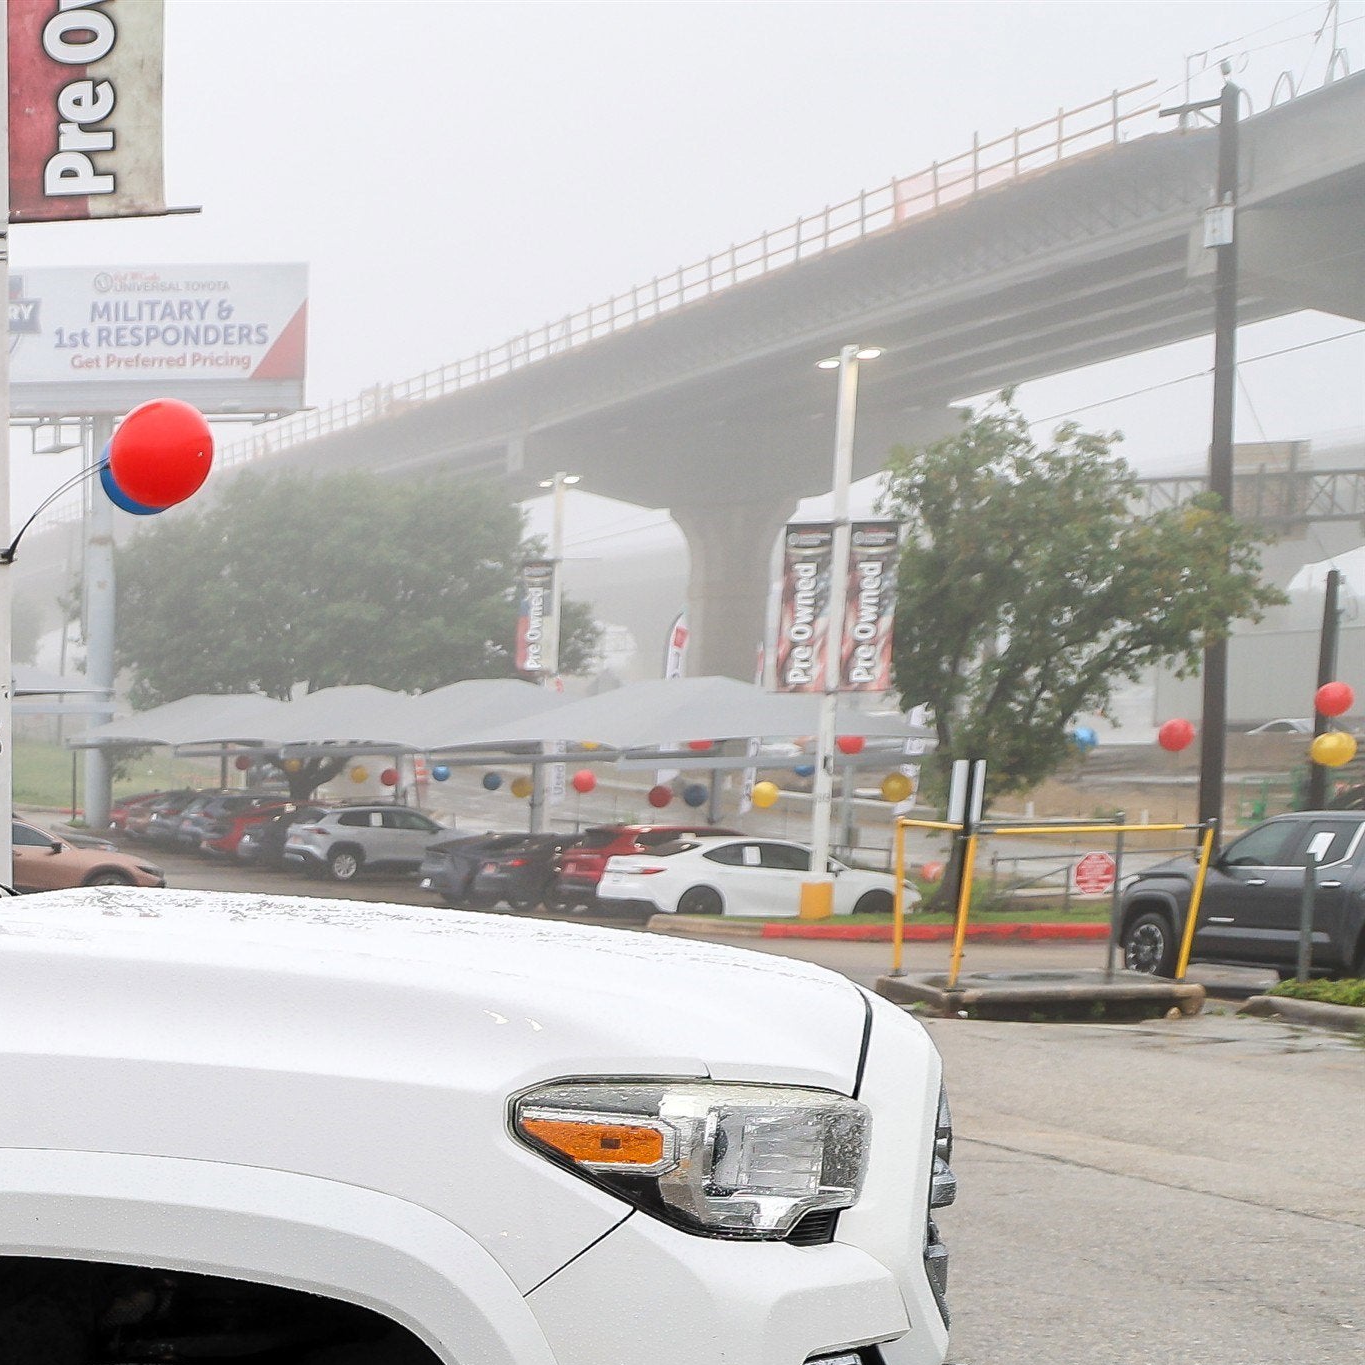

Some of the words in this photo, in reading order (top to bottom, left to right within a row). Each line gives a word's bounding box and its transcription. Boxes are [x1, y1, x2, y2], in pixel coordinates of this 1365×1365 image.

[44, 80, 115, 196] Pre
[113, 281, 182, 292] UNIVERSAL
[184, 280, 231, 291] TOYOTA
[90, 299, 213, 322] MILITARY
[217, 299, 235, 321] &
[53, 326, 91, 348] 1st
[97, 323, 270, 347] RESPONDERS
[71, 354, 101, 369] Get
[107, 353, 187, 368] Preferred
[192, 352, 252, 369] Pricing
[526, 587, 544, 641] Owned
[789, 561, 817, 642] Owned
[852, 561, 883, 642] Owned
[524, 642, 542, 671] Pre
[787, 645, 813, 684] Pre
[849, 644, 877, 683] Pre
